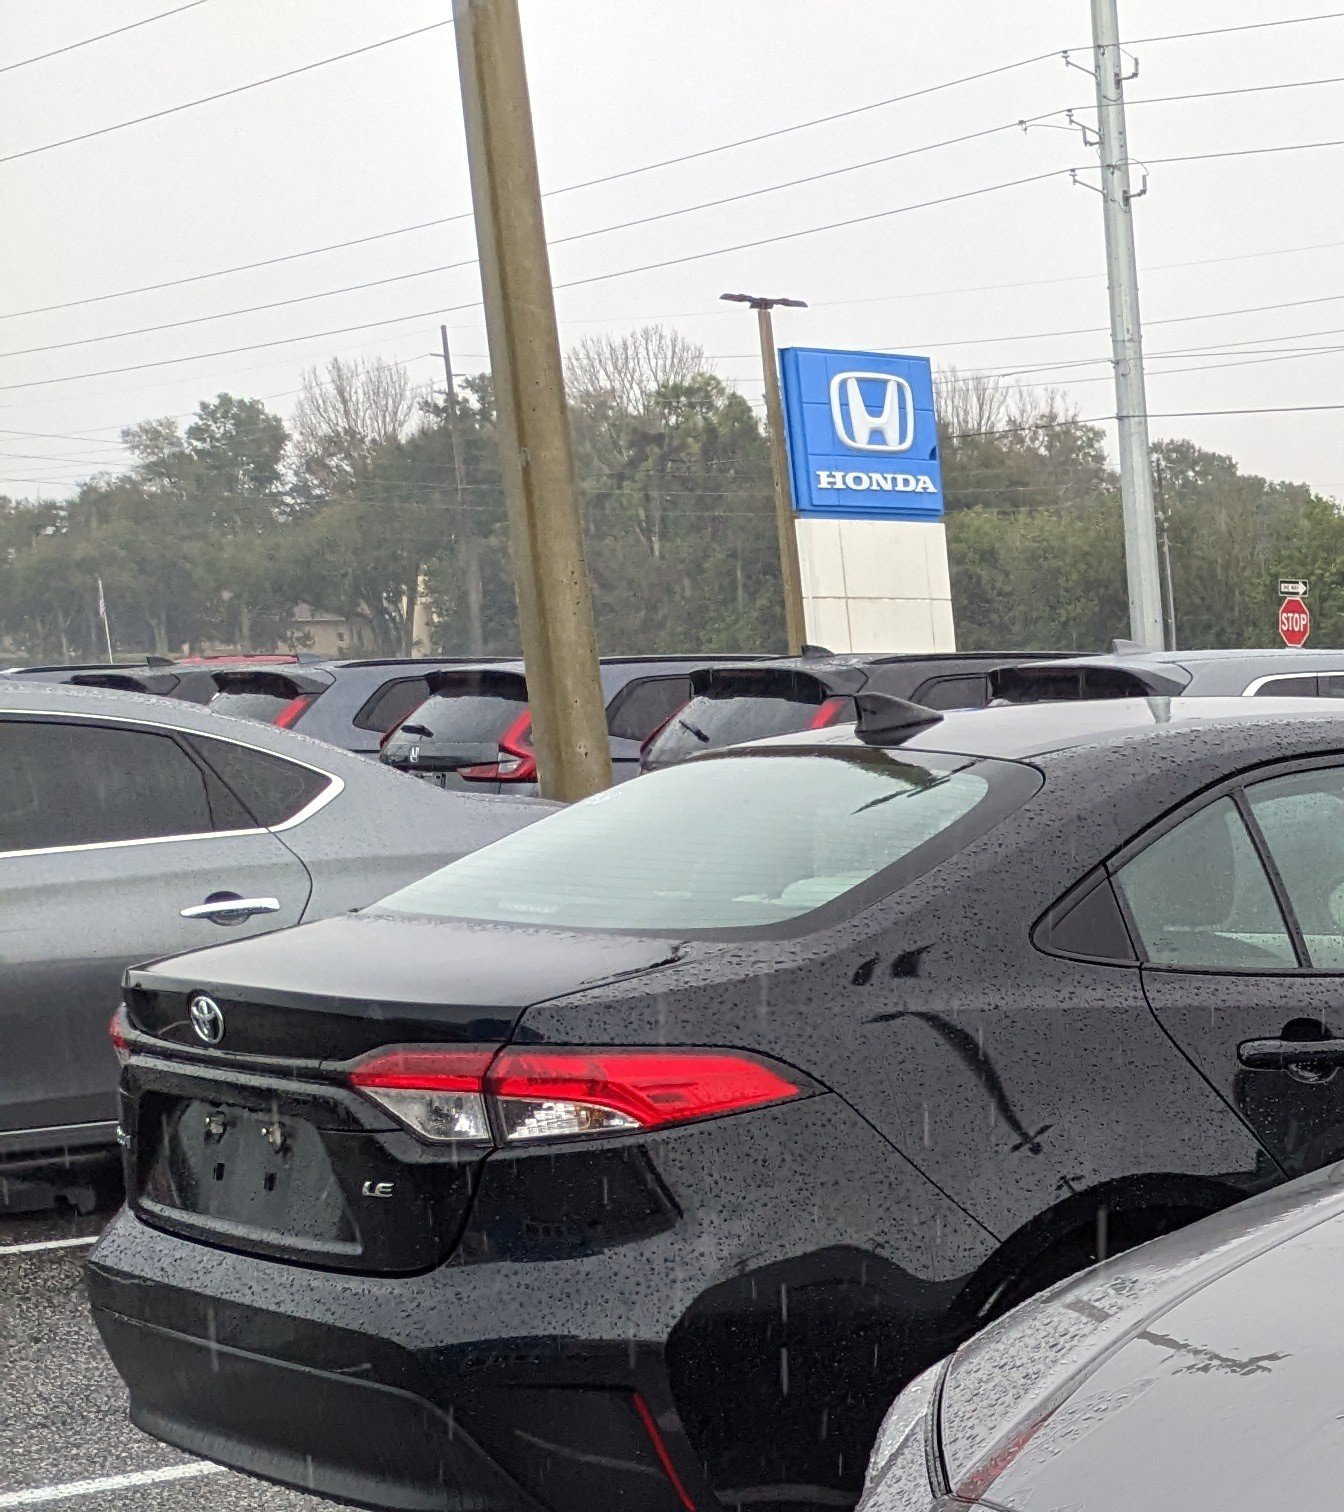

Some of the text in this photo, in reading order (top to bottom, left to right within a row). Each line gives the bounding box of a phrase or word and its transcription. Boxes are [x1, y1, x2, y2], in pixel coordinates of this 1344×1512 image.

[816, 470, 938, 493] HONDA
[1281, 612, 1307, 632] STOP
[361, 1181, 395, 1198] LE
